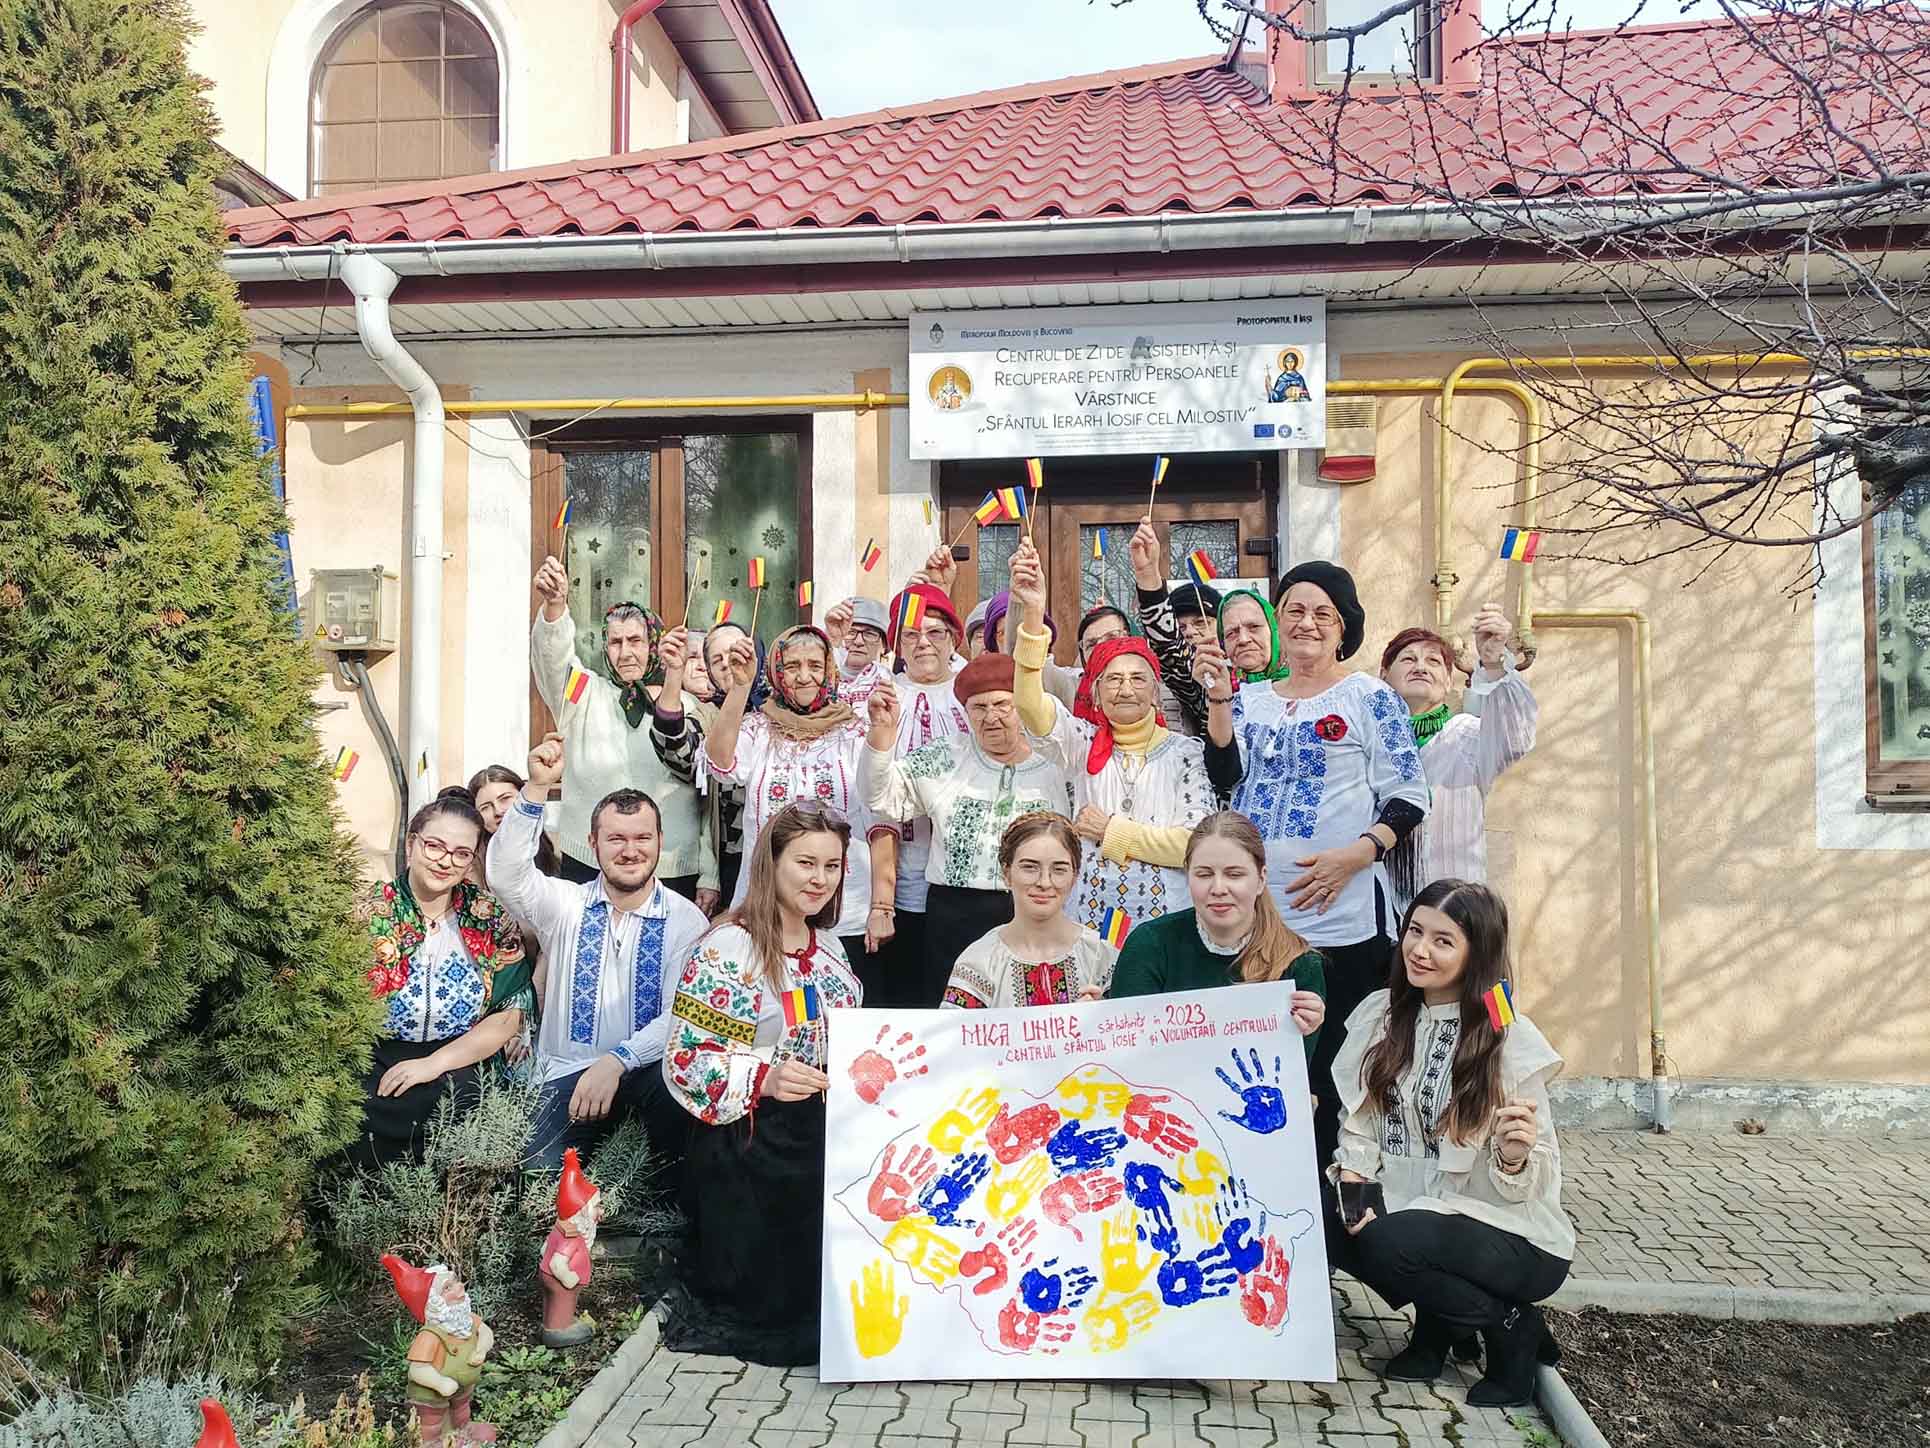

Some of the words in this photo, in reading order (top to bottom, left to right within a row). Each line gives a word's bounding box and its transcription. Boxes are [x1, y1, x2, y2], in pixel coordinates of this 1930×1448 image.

[996, 347, 1061, 363] CENTRUL
[1065, 347, 1083, 361] DE
[1086, 344, 1103, 360] ZI
[1106, 345, 1124, 361] DE
[995, 370, 1085, 387] RECUPERARE
[1088, 367, 1142, 384] PENTRU
[1146, 365, 1240, 382] PERSOANELE
[1075, 391, 1157, 407] VÂRSTNICE
[1053, 413, 1103, 429] IERARH
[1107, 410, 1143, 427] IOSIF
[1147, 411, 1173, 426] CEL
[961, 1018, 1009, 1046] MICA
[1165, 1003, 1207, 1026] 2023
[1223, 1014, 1279, 1036] CENTRULUI
